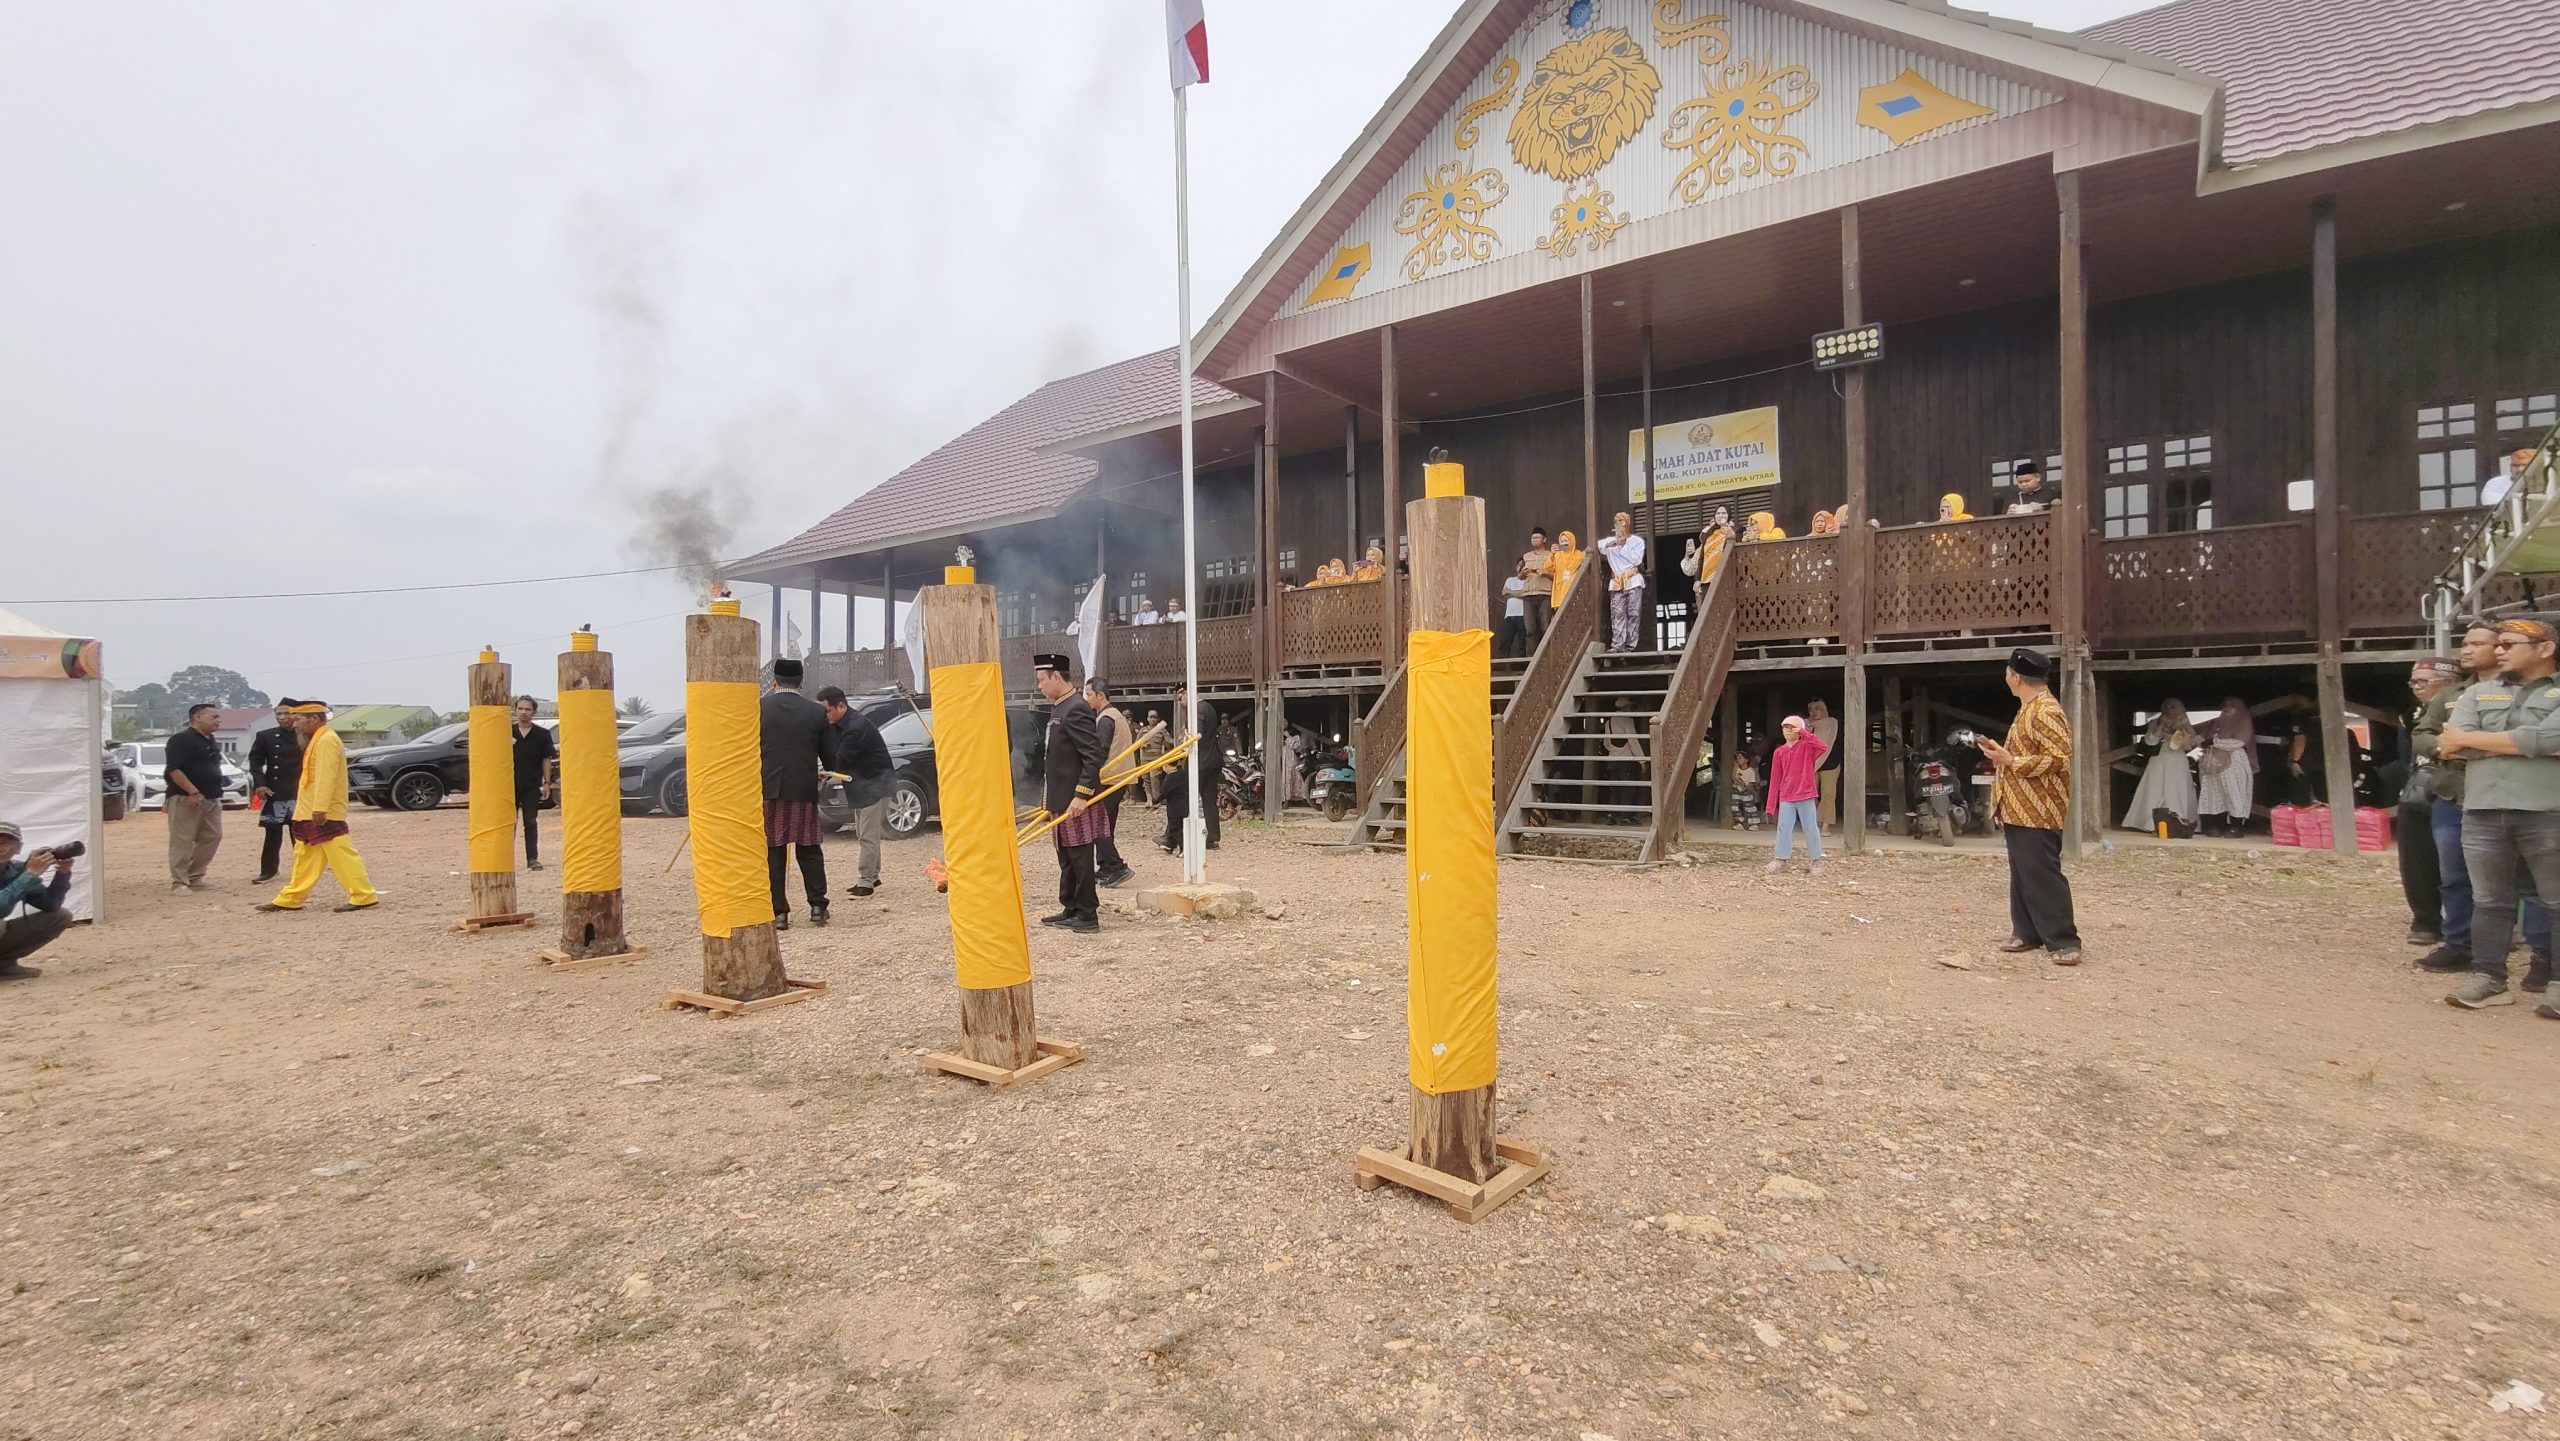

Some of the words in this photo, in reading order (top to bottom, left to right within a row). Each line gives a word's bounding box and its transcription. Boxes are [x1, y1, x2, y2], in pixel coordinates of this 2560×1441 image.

[1687, 448, 1721, 466] ADAT
[1725, 441, 1765, 460] KUTAI
[1655, 471, 1679, 481] KAB.
[1682, 466, 1712, 478] KUTAI
[1715, 460, 1750, 473] TIMUR
[1710, 476, 1748, 487] SANGATTA
[1749, 472, 1775, 481] UTARA
